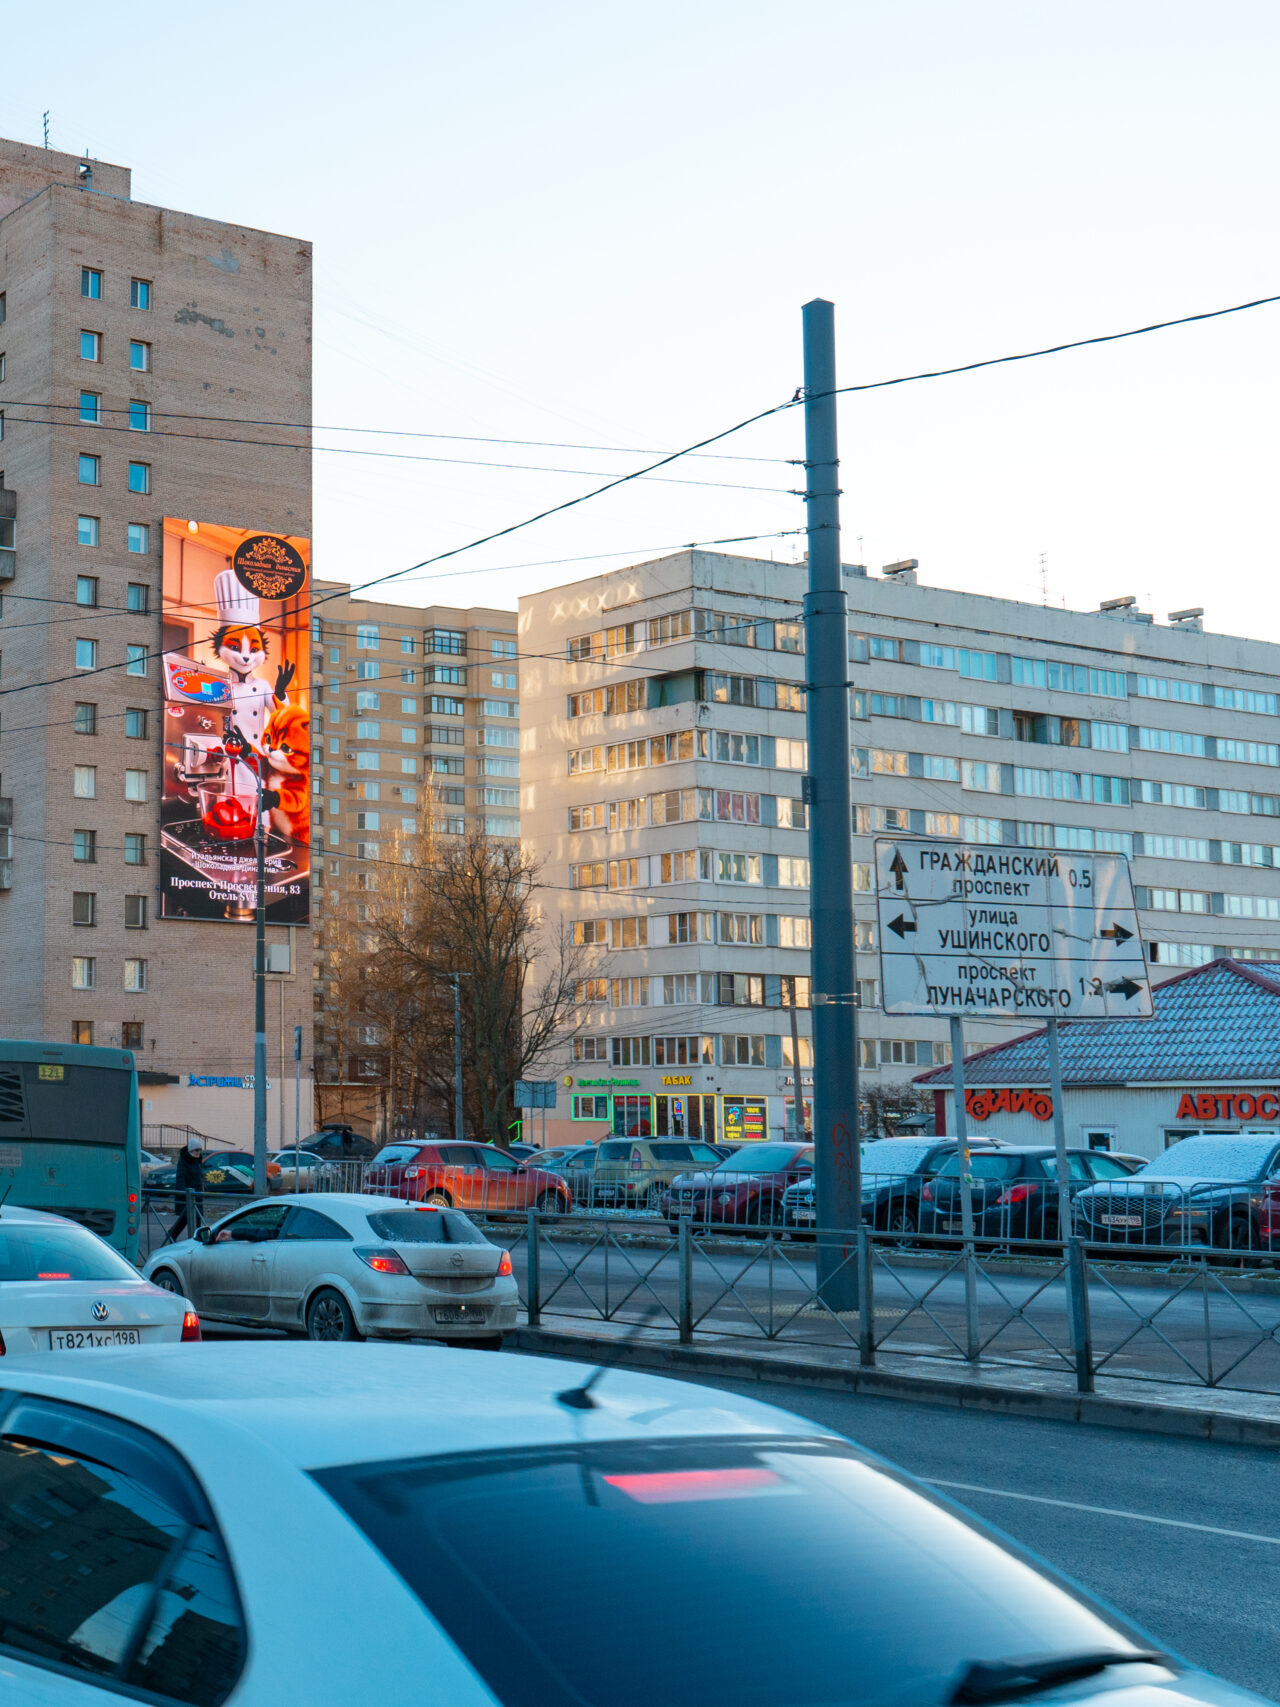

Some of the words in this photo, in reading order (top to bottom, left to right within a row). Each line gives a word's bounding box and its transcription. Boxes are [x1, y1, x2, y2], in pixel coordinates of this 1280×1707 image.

[191, 852, 237, 865] Итальянская
[238, 856, 282, 867] джелерия
[919, 851, 1060, 877] ГРАЖДАНСКИЙ
[242, 864, 280, 874] Динатия»
[171, 877, 217, 889] Проспект
[289, 884, 301, 895] 83
[208, 889, 238, 901] Отель
[953, 878, 1031, 898] проспект
[969, 907, 1018, 928] улица
[938, 929, 1051, 952] УШИНСКОГО
[958, 964, 1037, 982] проспект
[926, 985, 1071, 1008] ЛУНАЧАРСКОГО
[661, 1075, 691, 1086] ТАБАК
[1176, 1093, 1280, 1120] АВТОС
[114, 1331, 137, 1345] 198
